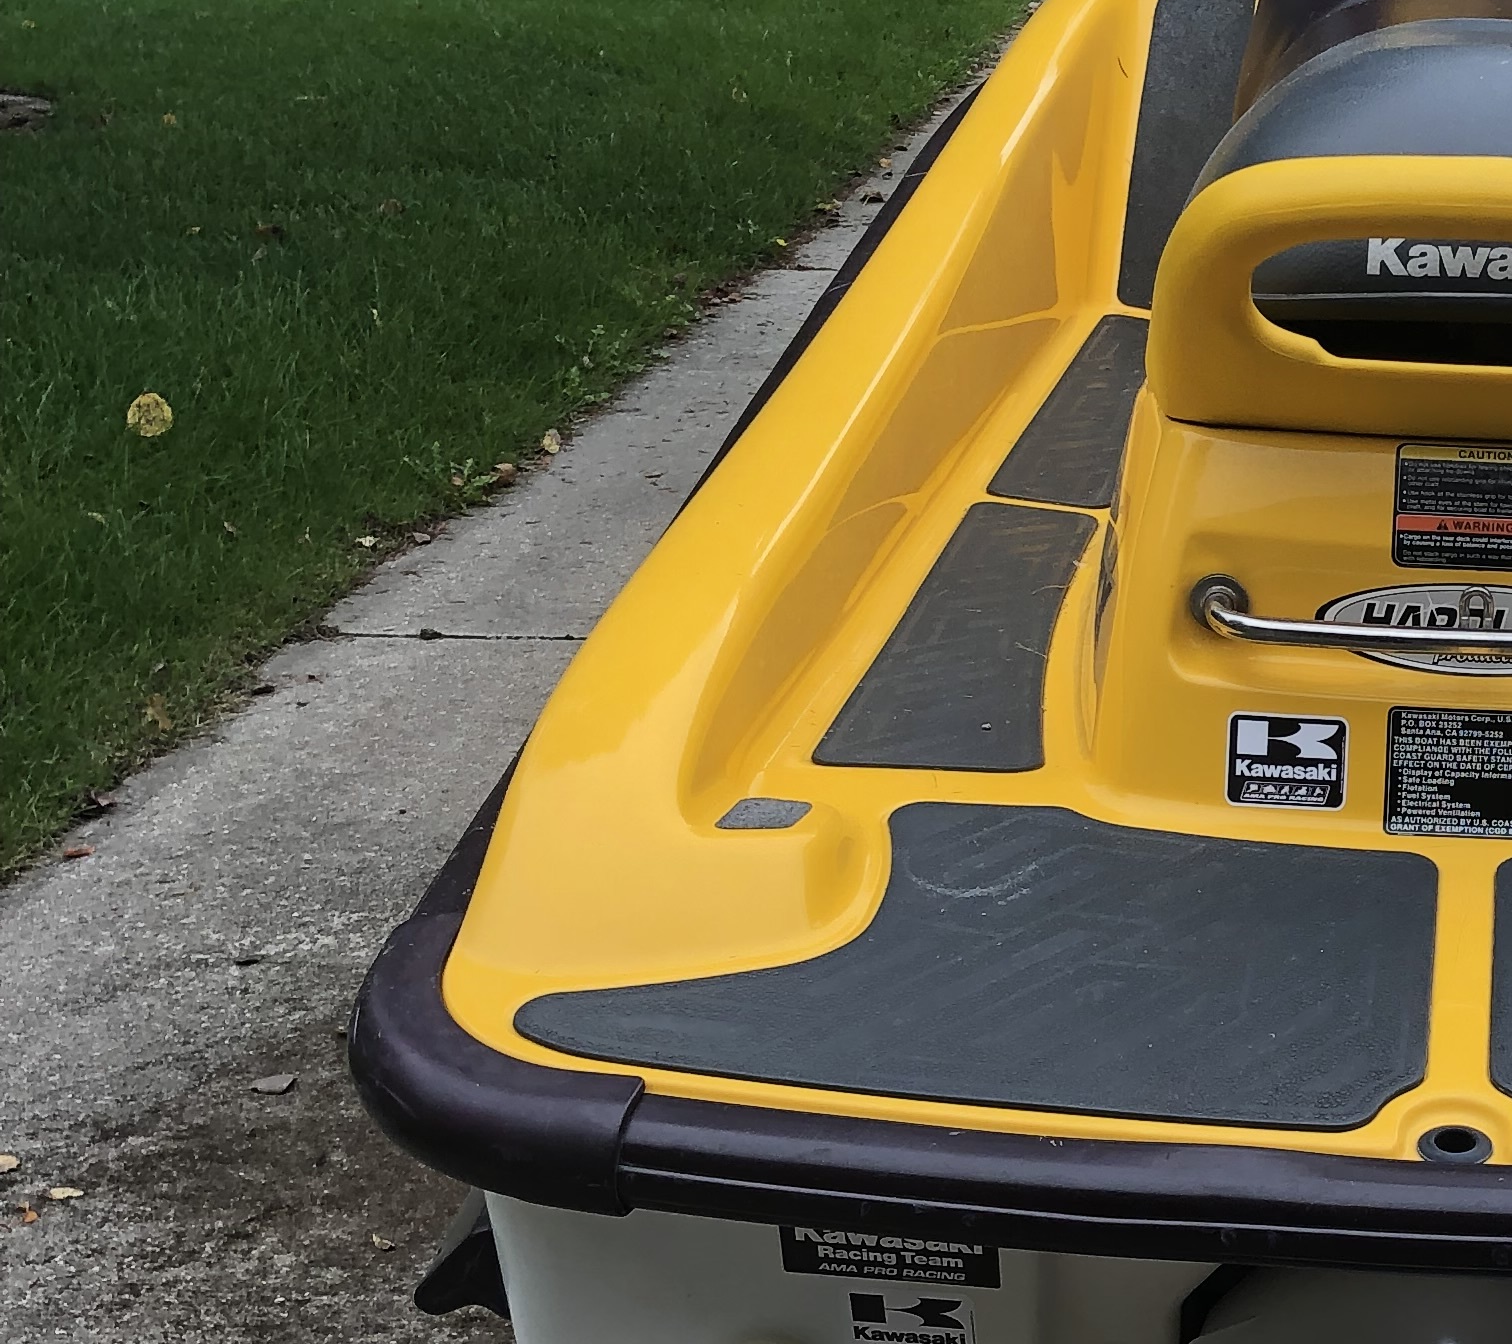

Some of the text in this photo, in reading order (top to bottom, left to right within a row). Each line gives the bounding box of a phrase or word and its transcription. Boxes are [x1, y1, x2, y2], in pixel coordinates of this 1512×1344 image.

[1402, 712, 1439, 720] Kawasaki
[1401, 727, 1423, 735] Santa
[1459, 730, 1504, 738] 92799-5252
[1394, 745, 1448, 753] COMPLIANCE
[1424, 753, 1454, 761] GUARD
[1235, 759, 1337, 781] Kawasaki
[1403, 768, 1432, 777] Display
[1445, 770, 1480, 779] Capacity
[1422, 777, 1454, 786] Loading
[1402, 784, 1438, 792] Flotation
[1402, 799, 1471, 809] Electrical System
[1401, 807, 1480, 817] Powered Ventilation
[1404, 817, 1458, 825] AUTHORIZED
[1435, 826, 1484, 834] EXEMPTION
[817, 1245, 964, 1268] Racing Team
[818, 1262, 966, 1281] AMA PRO RACING
